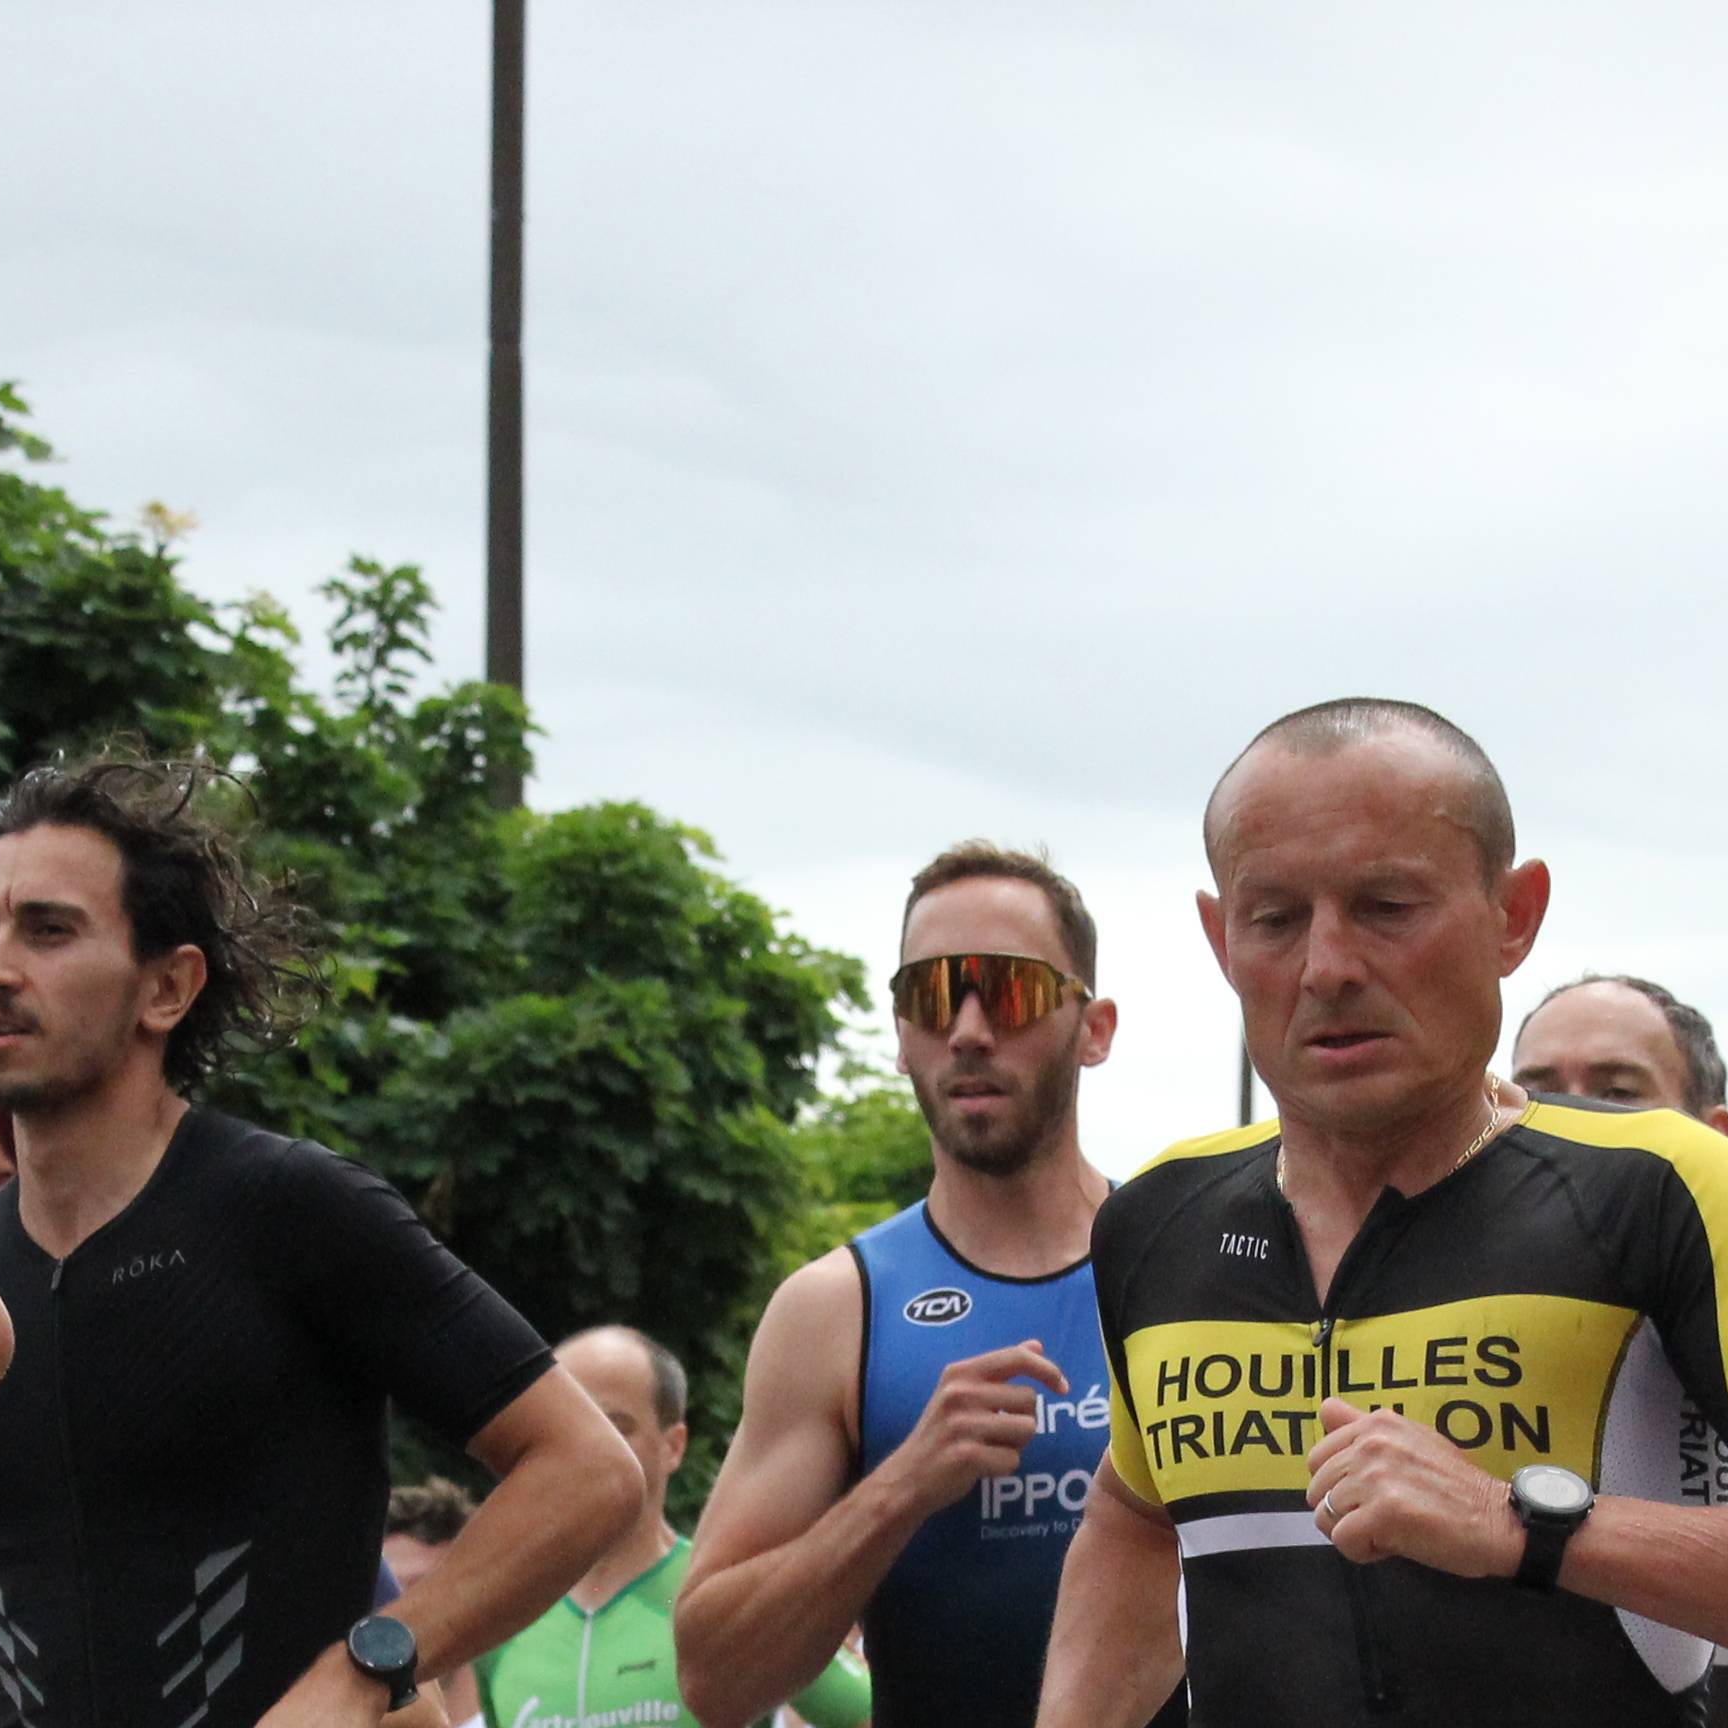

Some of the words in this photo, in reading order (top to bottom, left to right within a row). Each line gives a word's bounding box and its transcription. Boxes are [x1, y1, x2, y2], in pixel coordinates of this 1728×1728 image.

[1219, 1232, 1268, 1259] TACTIC
[913, 1295, 962, 1319] TCA
[1157, 1336, 1524, 1407] HOUILLES
[1146, 1400, 1552, 1470] TRIATON
